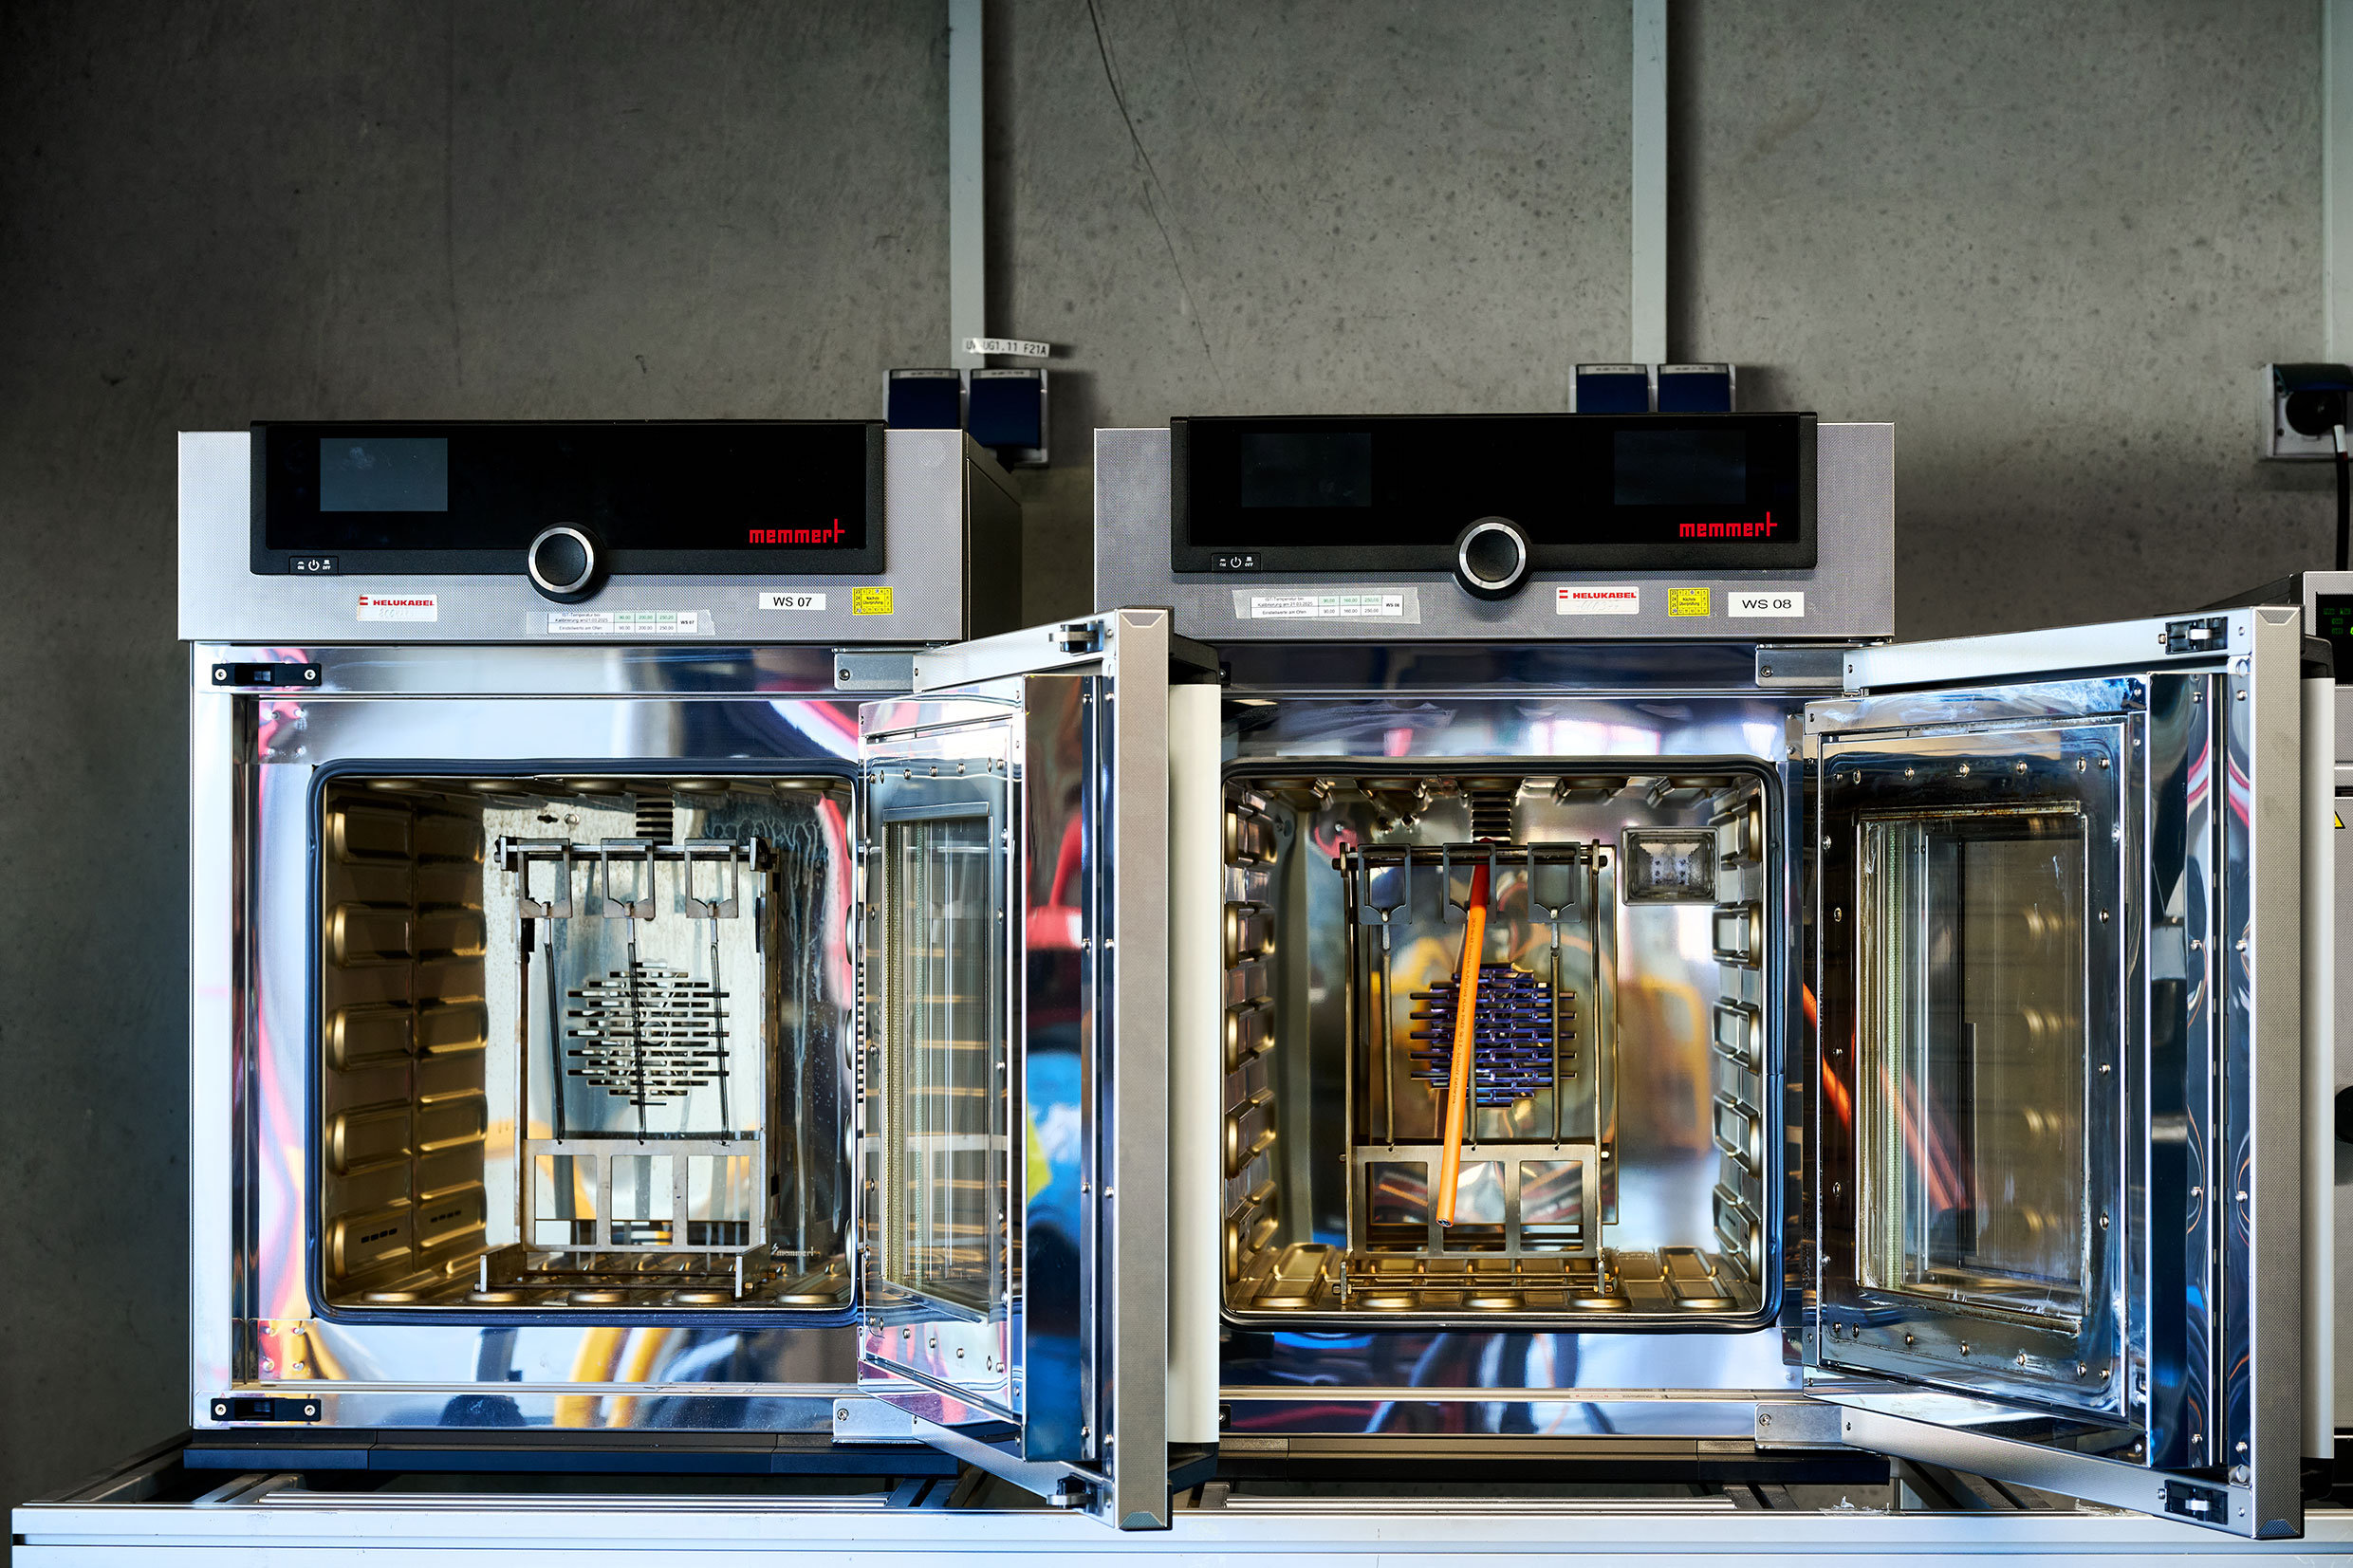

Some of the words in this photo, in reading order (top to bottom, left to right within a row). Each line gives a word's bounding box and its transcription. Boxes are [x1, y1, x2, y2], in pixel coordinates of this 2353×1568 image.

[1024, 343, 1047, 355] F21A
[1678, 511, 1777, 537] memmert
[749, 519, 845, 544] memmert
[773, 597, 793, 606] WS
[797, 597, 812, 607] 07
[1742, 600, 1768, 609] WS
[1772, 599, 1791, 609] 08
